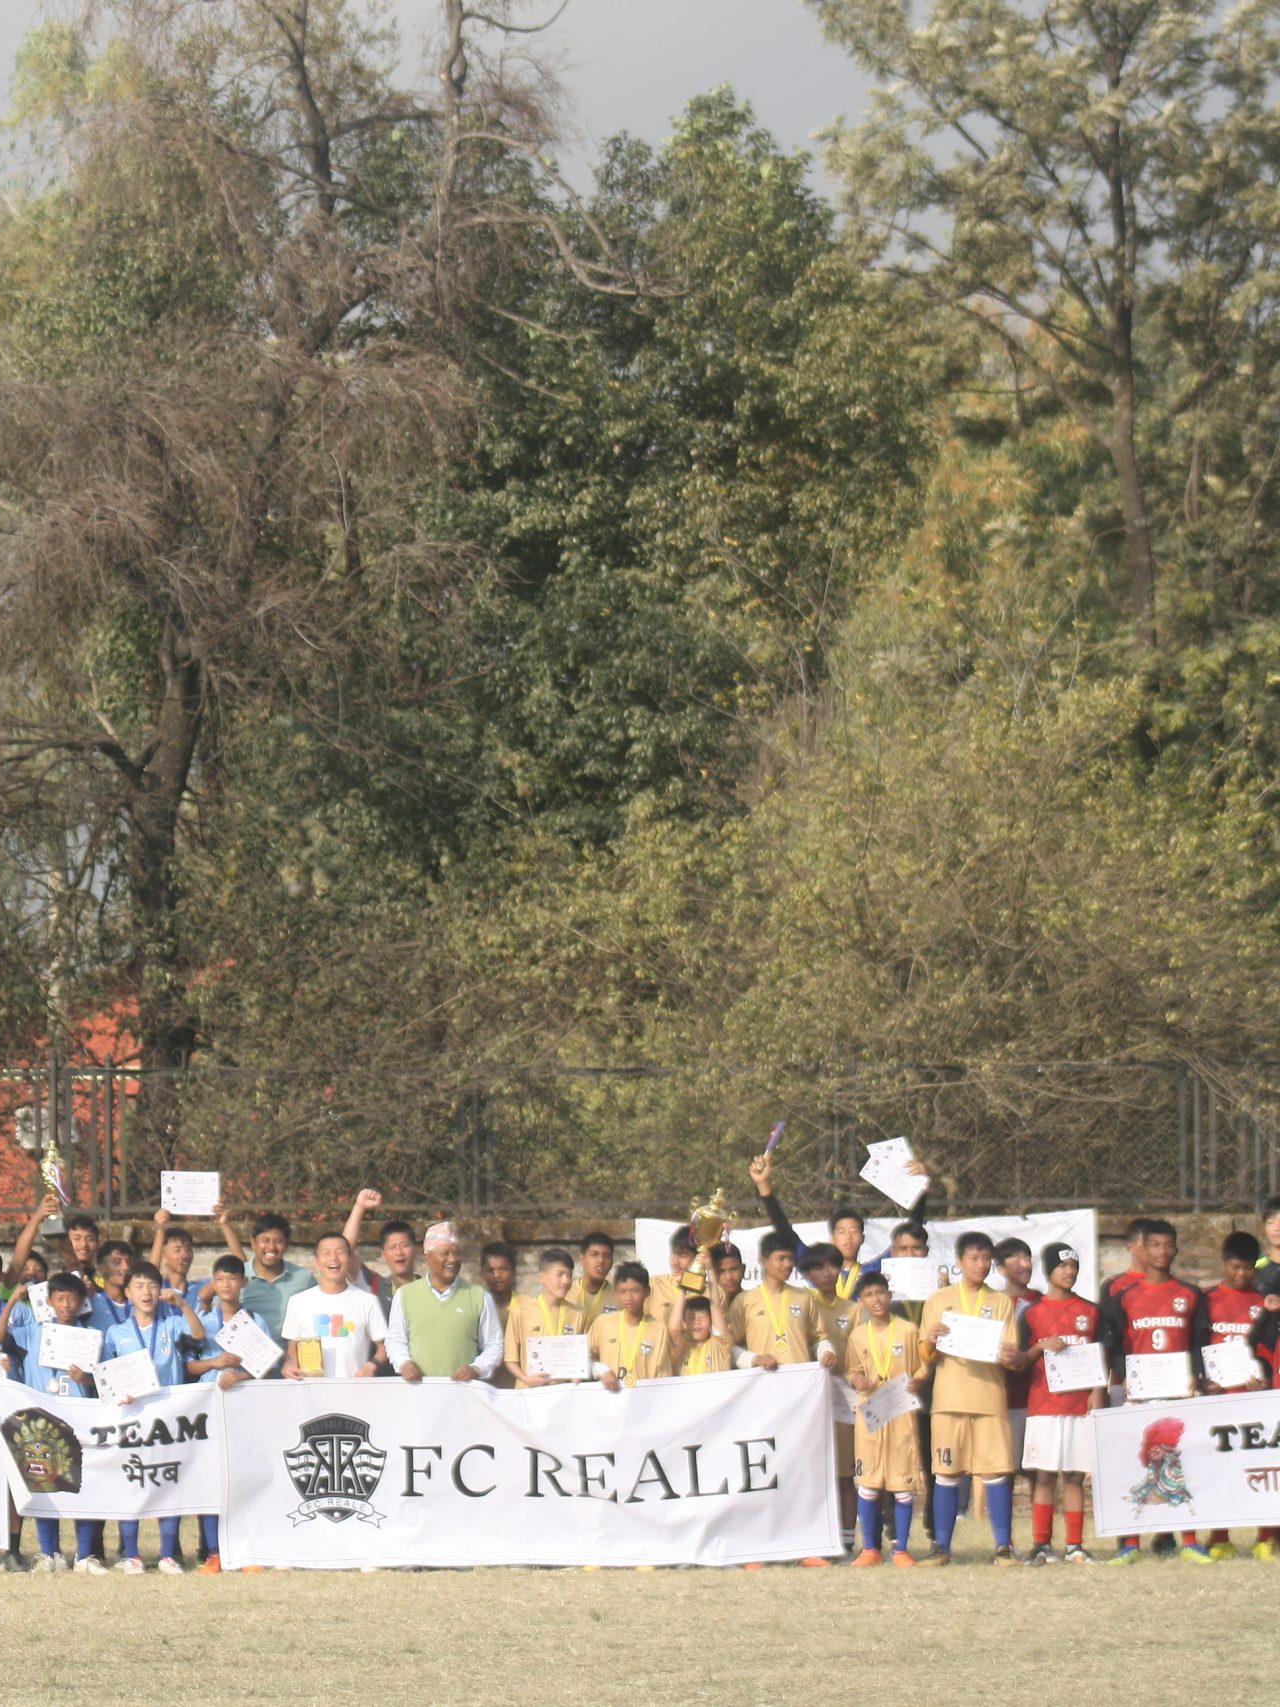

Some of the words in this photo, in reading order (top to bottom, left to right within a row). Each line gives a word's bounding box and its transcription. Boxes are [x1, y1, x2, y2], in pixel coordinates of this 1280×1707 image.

[1132, 1316, 1187, 1329] HORIBA
[1151, 1329, 1166, 1351] 9
[88, 1412, 209, 1449] TEAM
[935, 1447, 952, 1467] 14
[399, 1443, 497, 1498] FC
[523, 1436, 779, 1504] REALE
[327, 1498, 367, 1512] REALE
